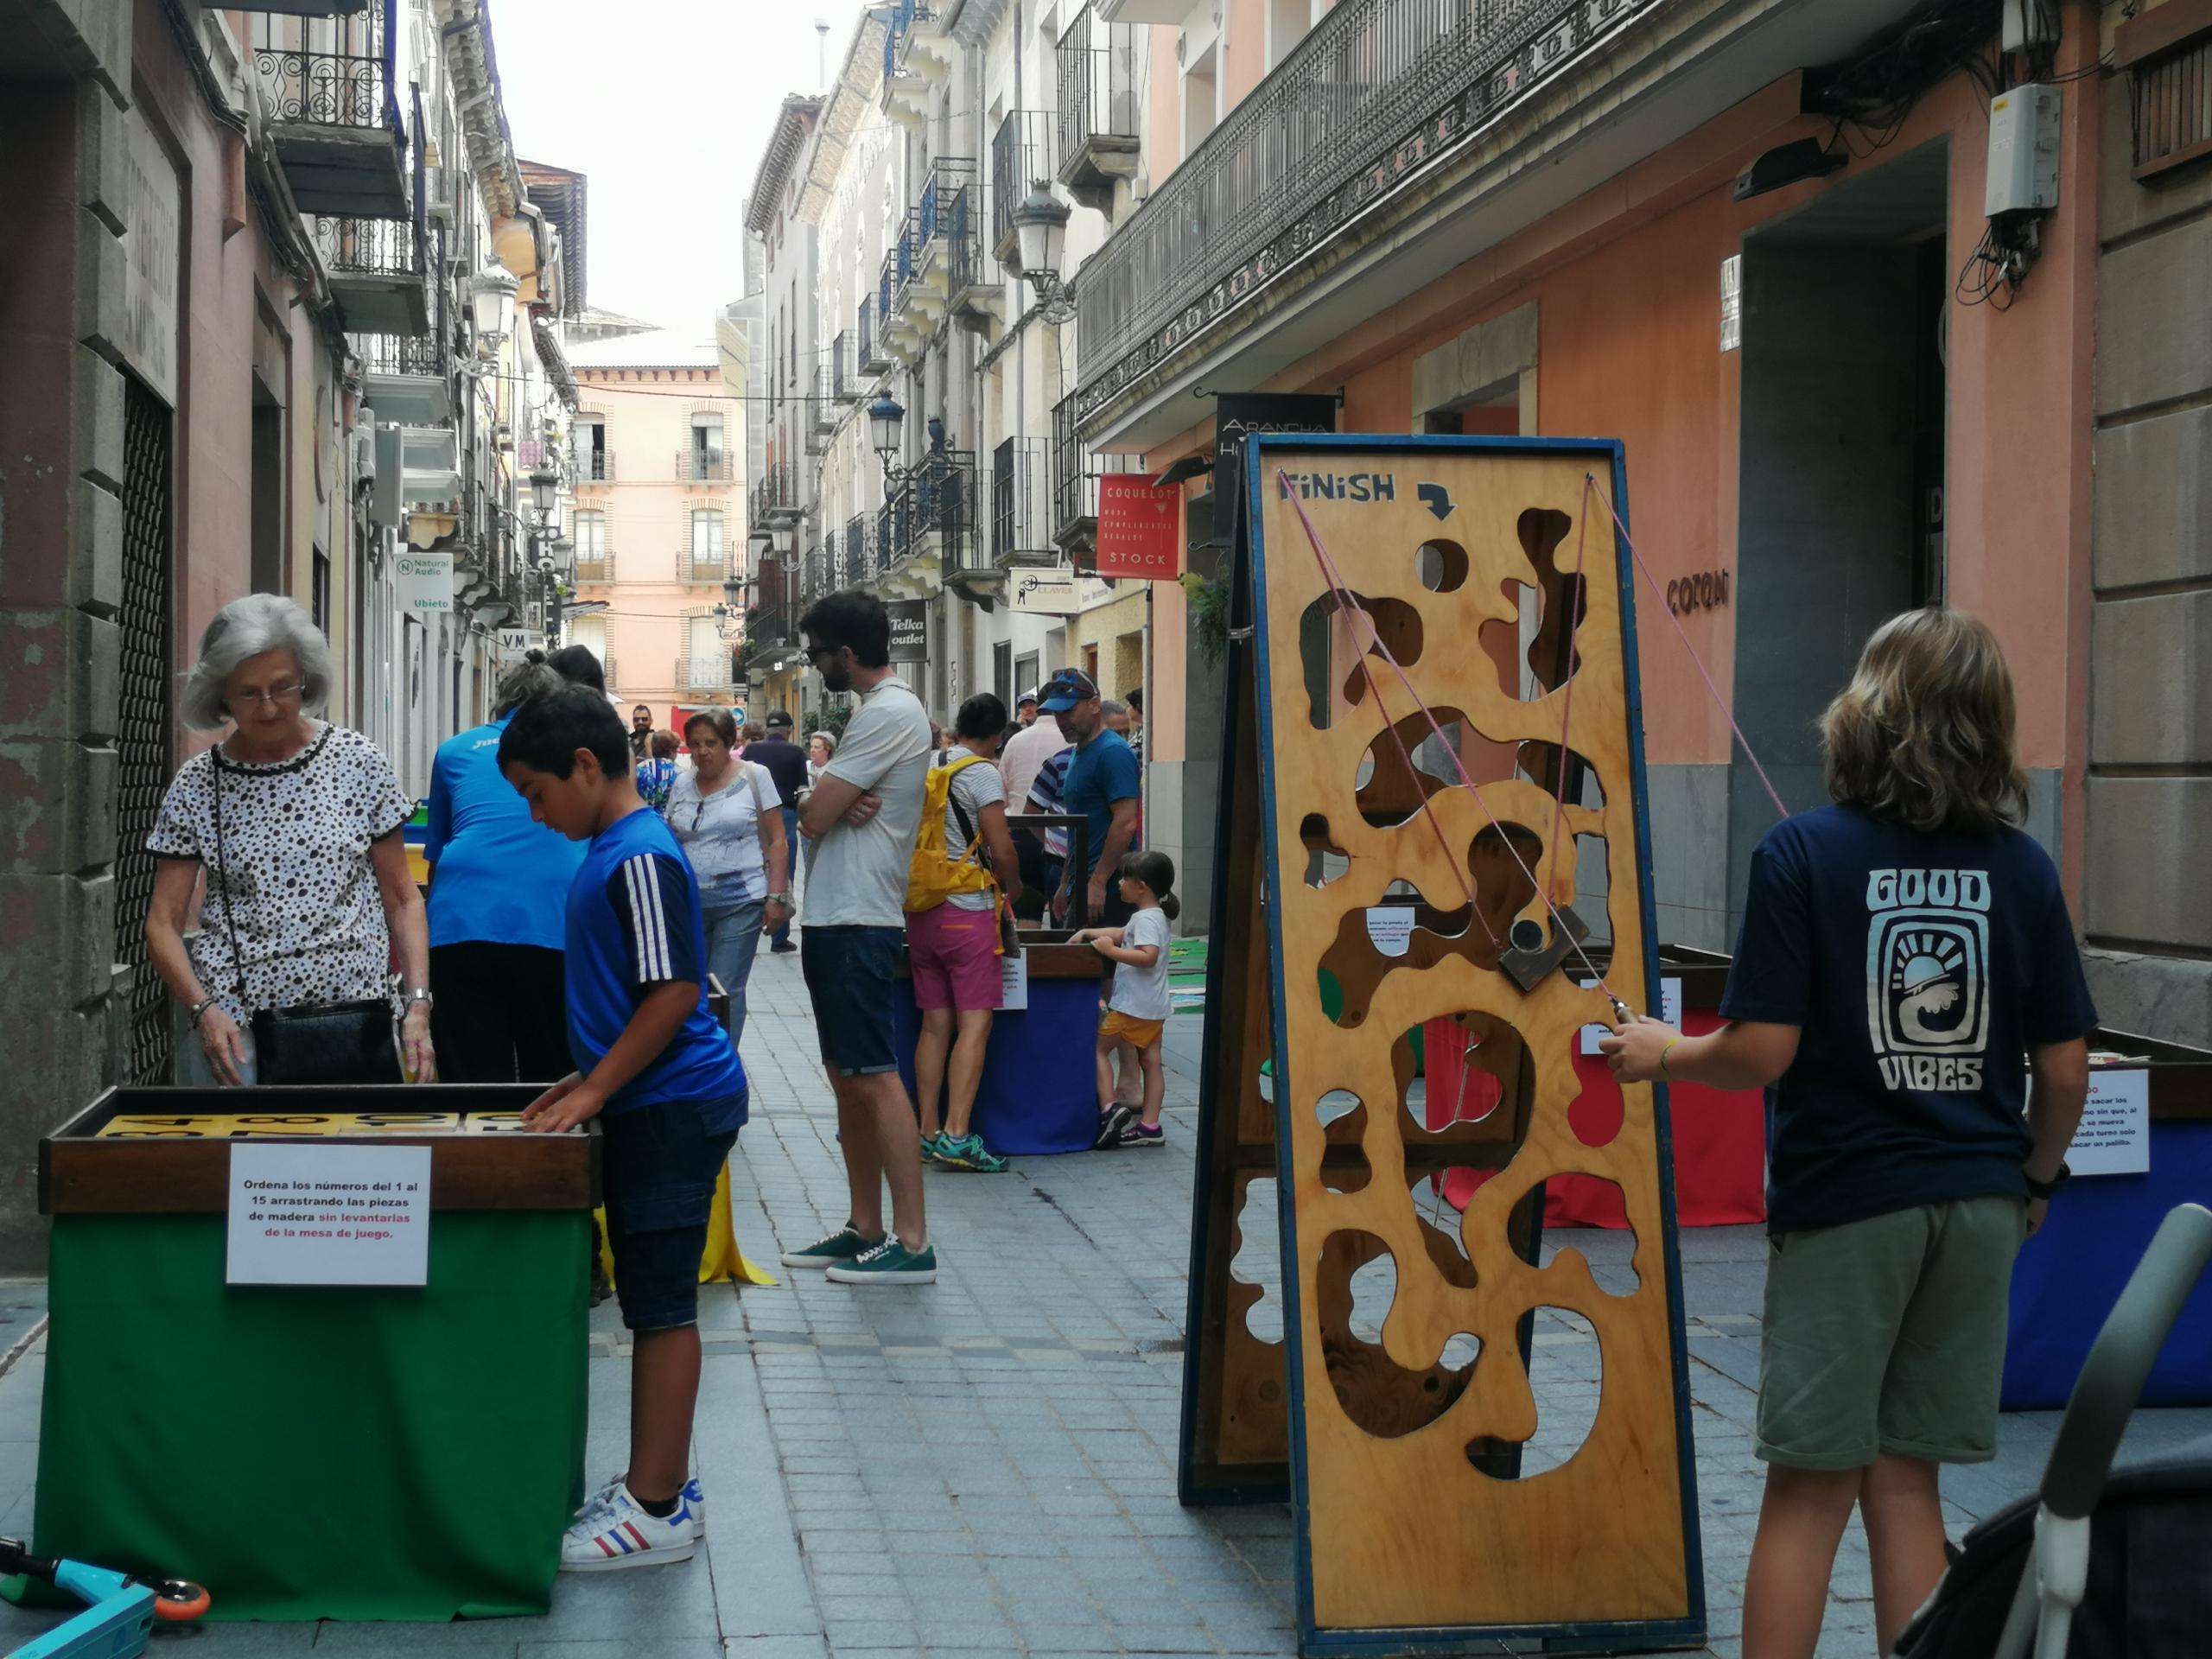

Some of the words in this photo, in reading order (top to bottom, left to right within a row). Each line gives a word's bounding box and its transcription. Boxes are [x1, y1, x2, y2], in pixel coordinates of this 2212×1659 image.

[1109, 552, 1166, 565] STOCK
[414, 599, 448, 608] Ubieto
[890, 618, 924, 631] Telka
[891, 633, 925, 645] outlet
[1866, 868, 1992, 912] GOOD
[1877, 1055, 1984, 1091] VIBES
[244, 1180, 289, 1190] Ordena
[293, 1180, 311, 1191] los
[315, 1180, 368, 1192] números
[372, 1181, 391, 1192] del
[396, 1182, 402, 1192] 1
[406, 1182, 417, 1192] al
[251, 1196, 266, 1205] 15
[270, 1197, 343, 1206] arrastrando
[347, 1197, 365, 1207] las
[369, 1198, 410, 1210] piezas
[249, 1211, 264, 1221] de
[268, 1212, 315, 1222] madera
[319, 1212, 337, 1223] sin
[341, 1213, 410, 1224] levantarlas
[264, 1228, 279, 1237] de
[284, 1228, 295, 1237] la
[299, 1230, 333, 1238] mesa
[337, 1229, 351, 1238] de
[355, 1229, 393, 1240] juego.
